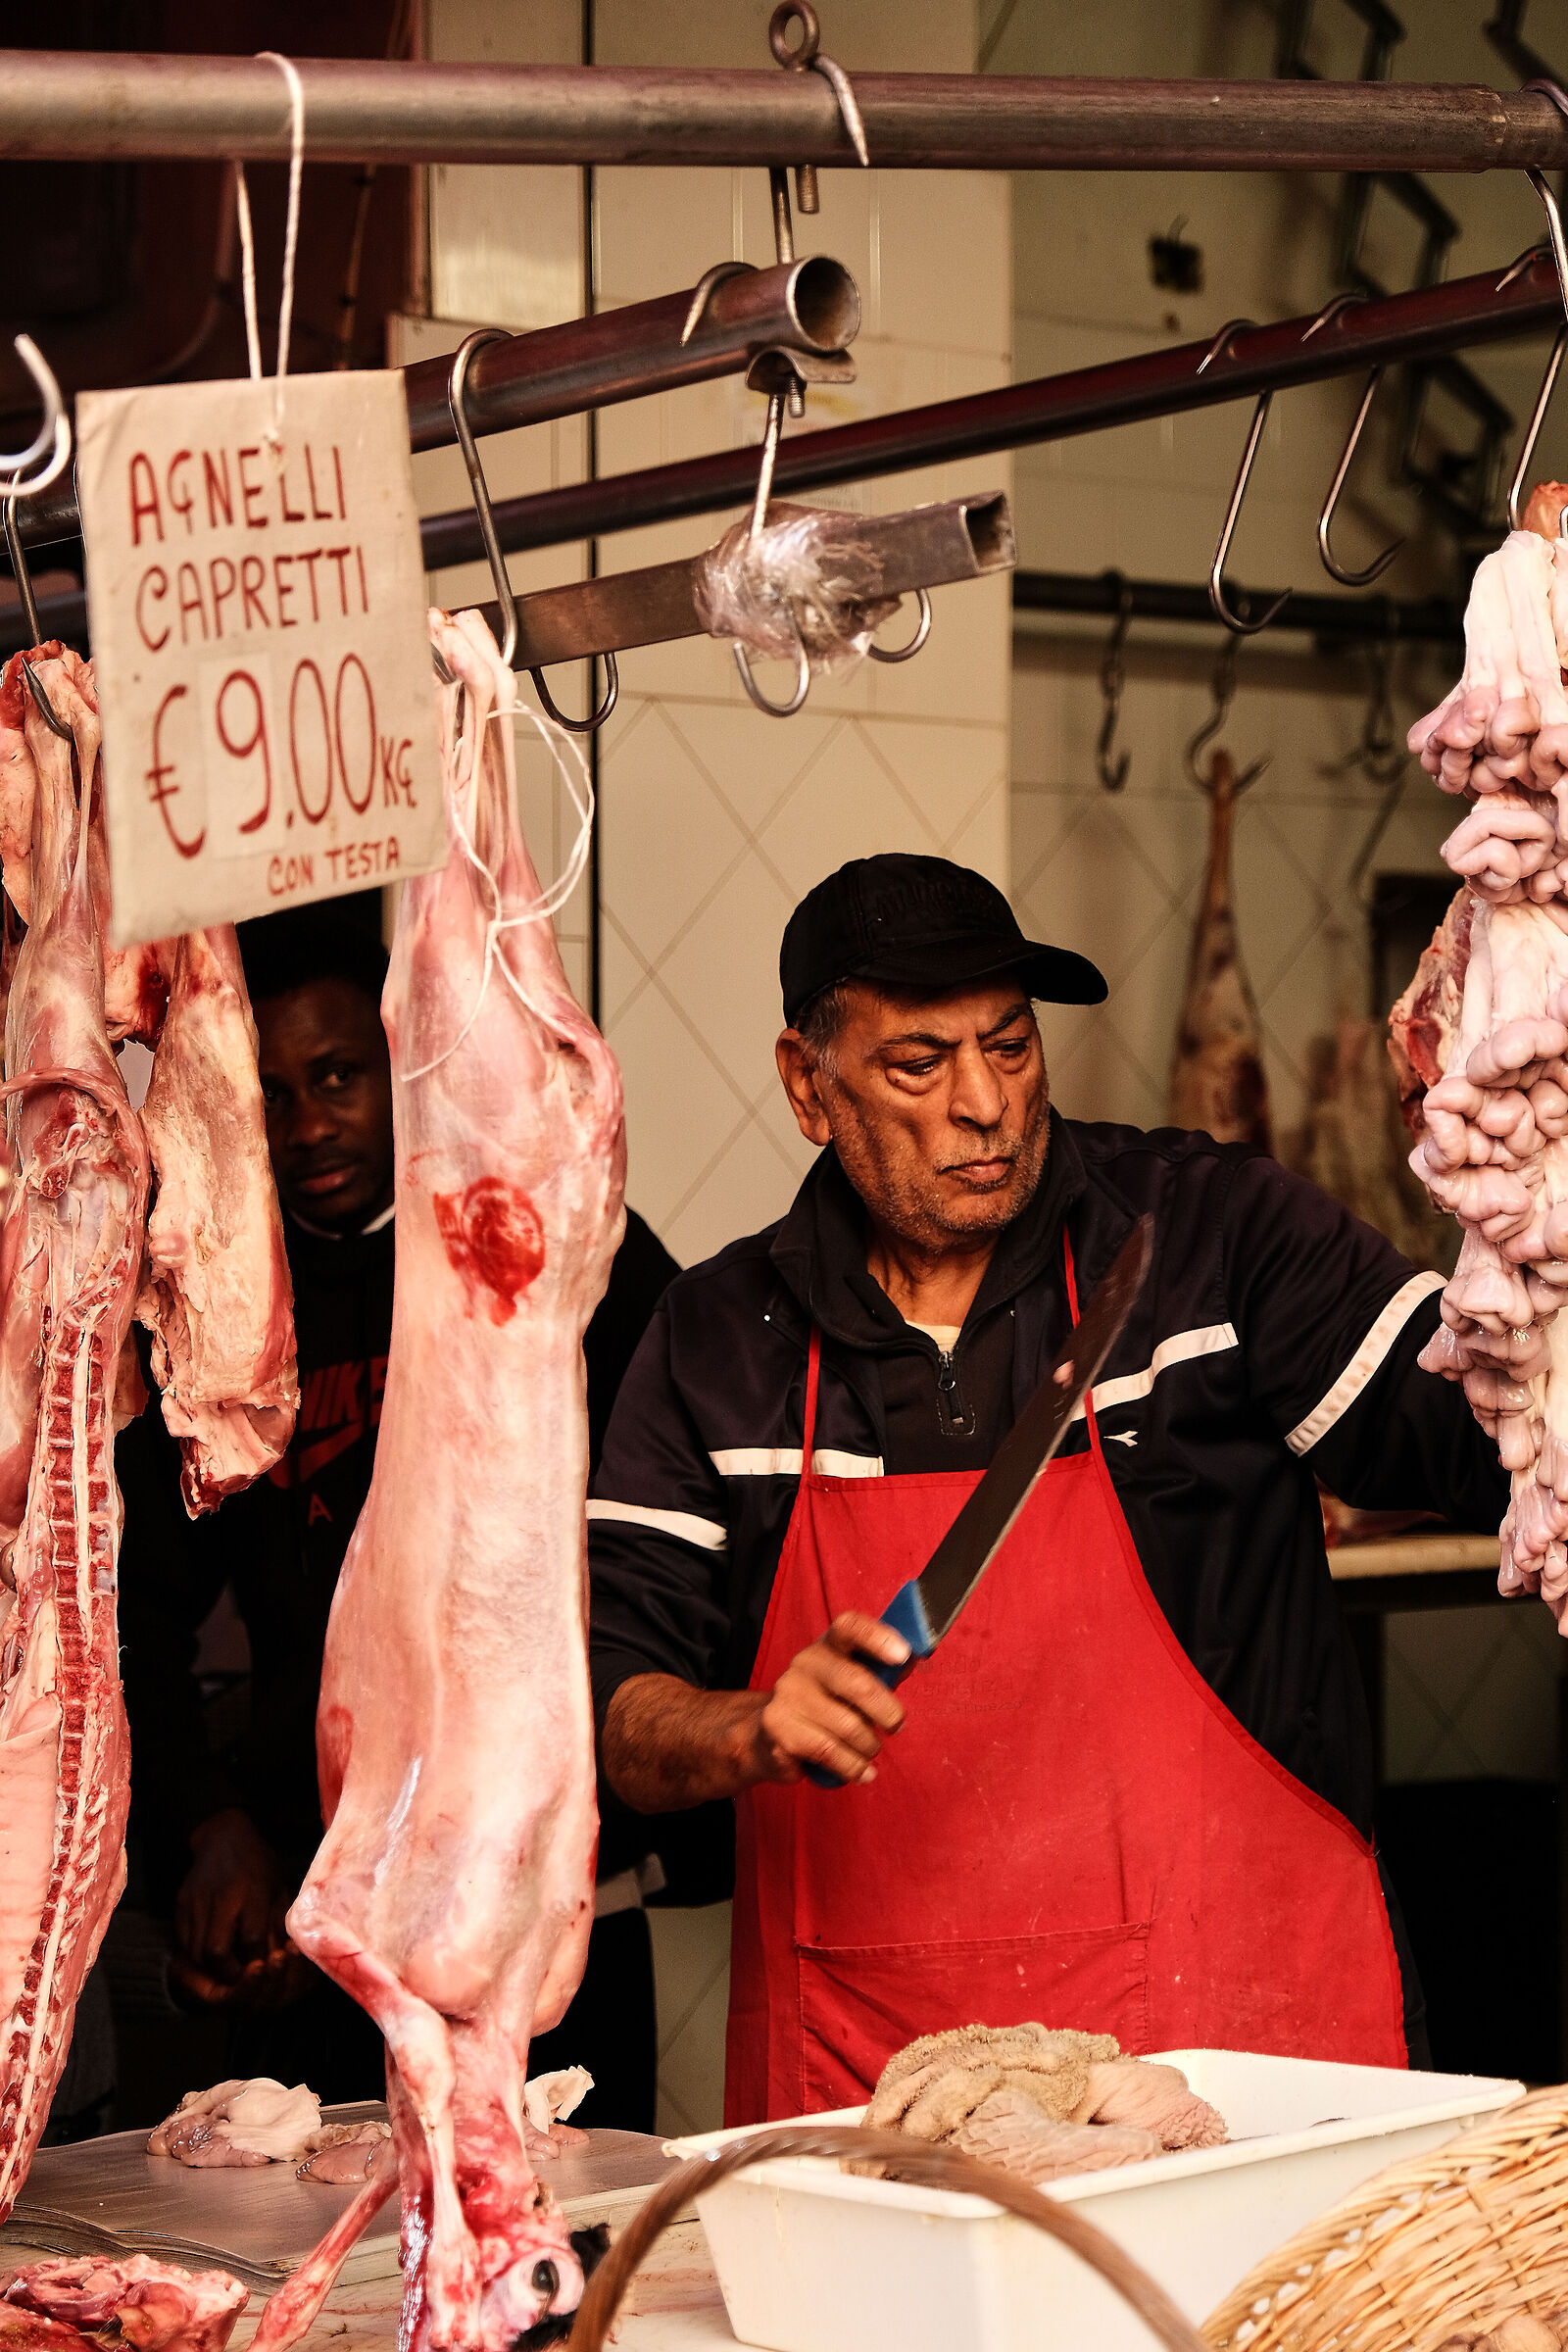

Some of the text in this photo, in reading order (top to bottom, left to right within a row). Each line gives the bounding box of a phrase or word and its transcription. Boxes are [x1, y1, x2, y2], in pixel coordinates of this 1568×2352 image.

[128, 444, 347, 547] AGNELLI
[135, 546, 369, 653] CAPRETTI
[267, 836, 401, 897] CON TESTA
